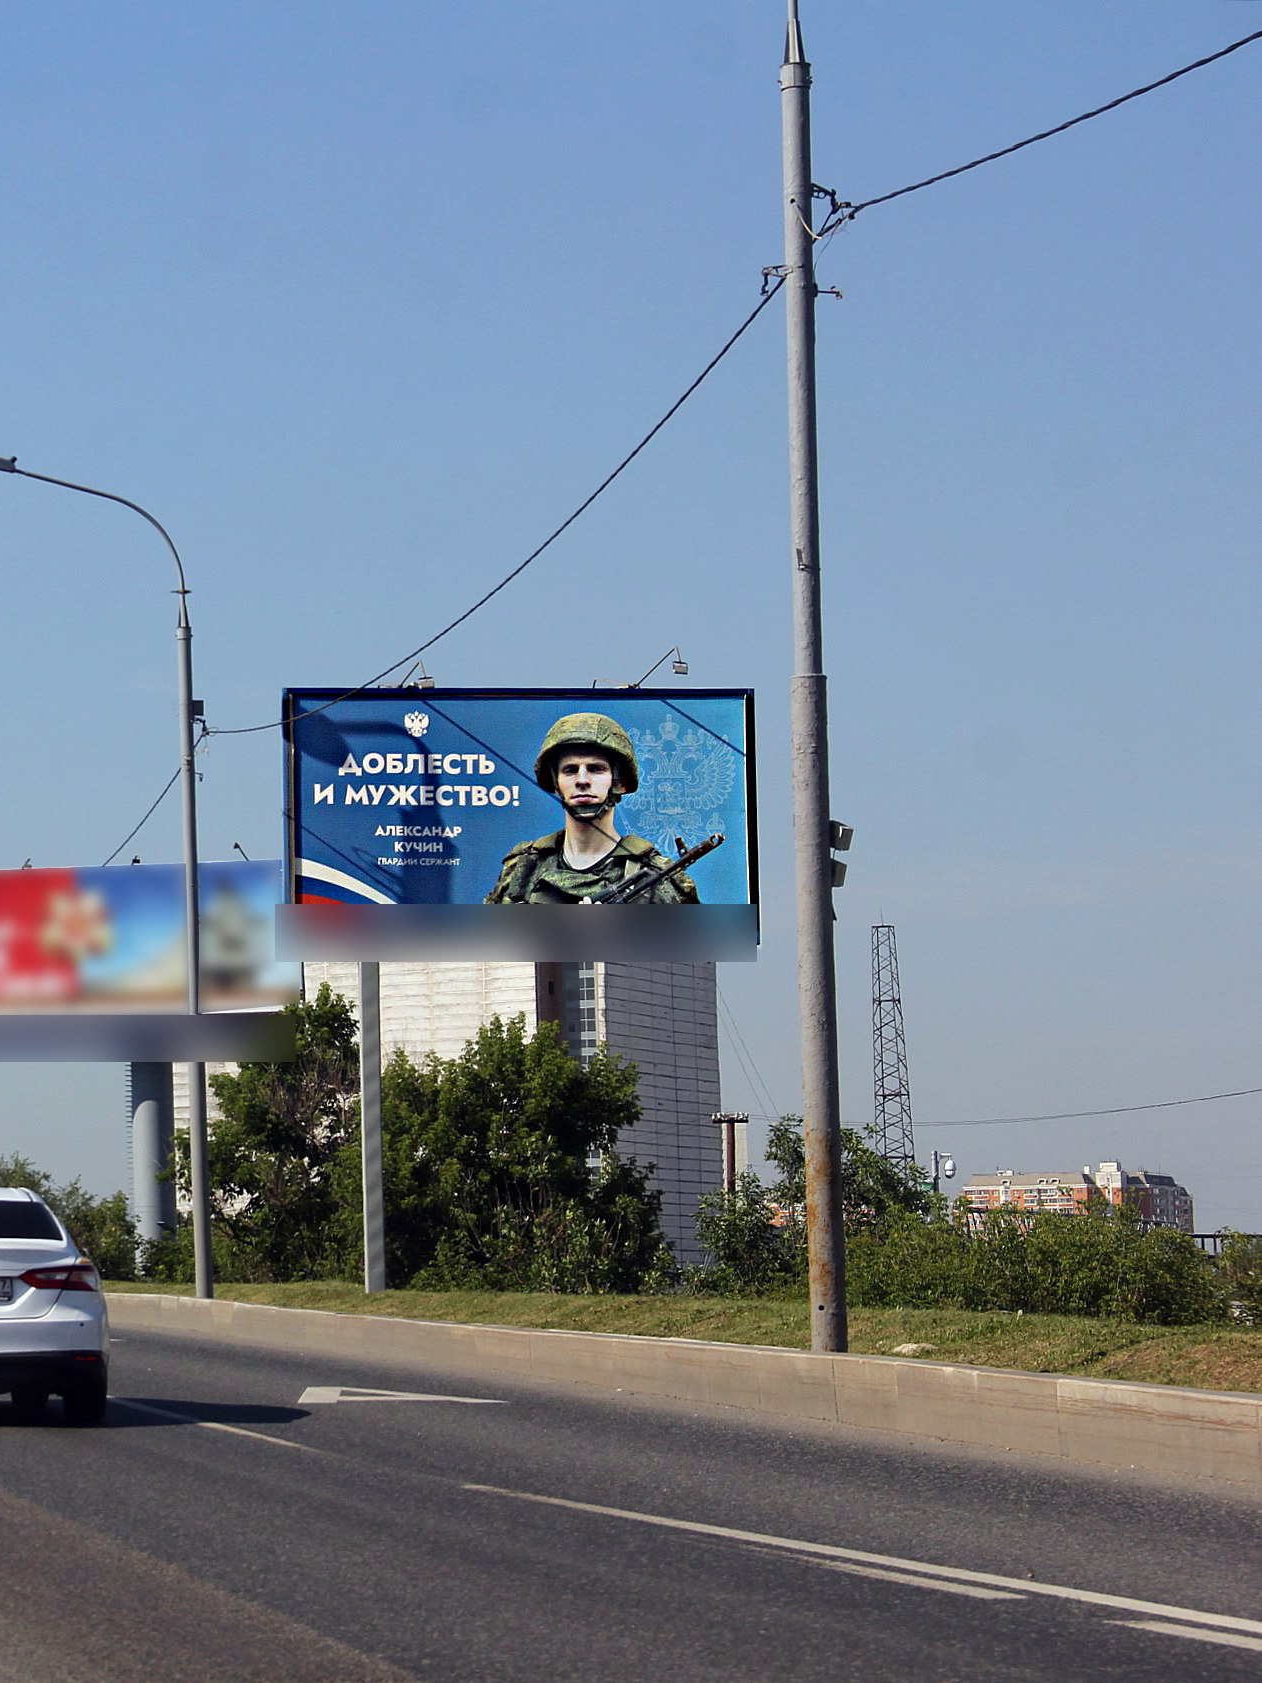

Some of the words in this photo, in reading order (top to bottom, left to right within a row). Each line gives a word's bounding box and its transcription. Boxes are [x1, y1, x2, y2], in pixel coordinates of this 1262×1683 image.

[338, 753, 495, 776] ДОБЛЕСТЬ
[314, 784, 334, 804] И
[345, 785, 520, 806] МУЖЕСТВО!
[374, 825, 462, 838] АЛЕКСАНДР
[394, 841, 443, 852] КУЧИН
[377, 858, 418, 867] ГВАРДИИ
[419, 858, 461, 866] СЕРЖАНТ
